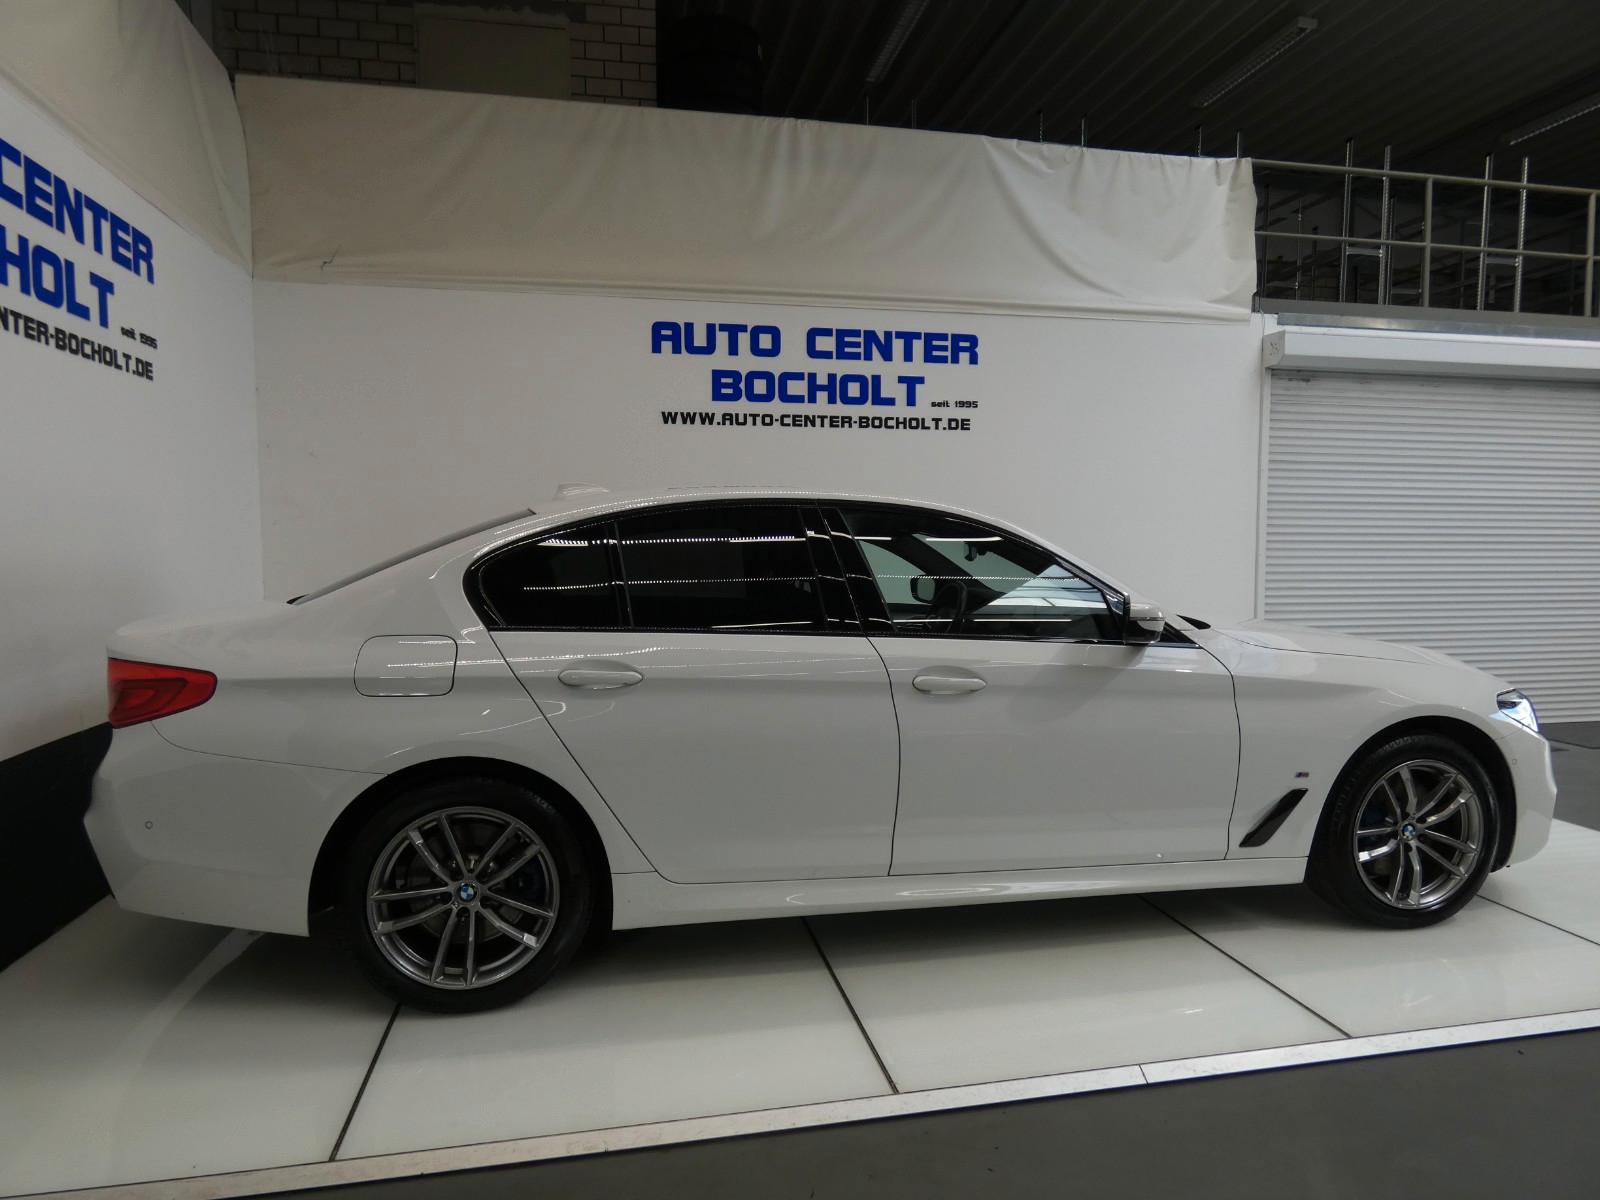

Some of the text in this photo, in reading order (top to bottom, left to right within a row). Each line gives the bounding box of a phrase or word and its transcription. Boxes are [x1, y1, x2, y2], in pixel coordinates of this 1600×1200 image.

[0, 137, 155, 285] CENTER
[651, 321, 979, 365] AUTO CENTER
[711, 369, 979, 409] BOCHOLT seit 1995
[661, 411, 971, 431] WWW.AUTO-CENTER-BOCHOLT.DE
